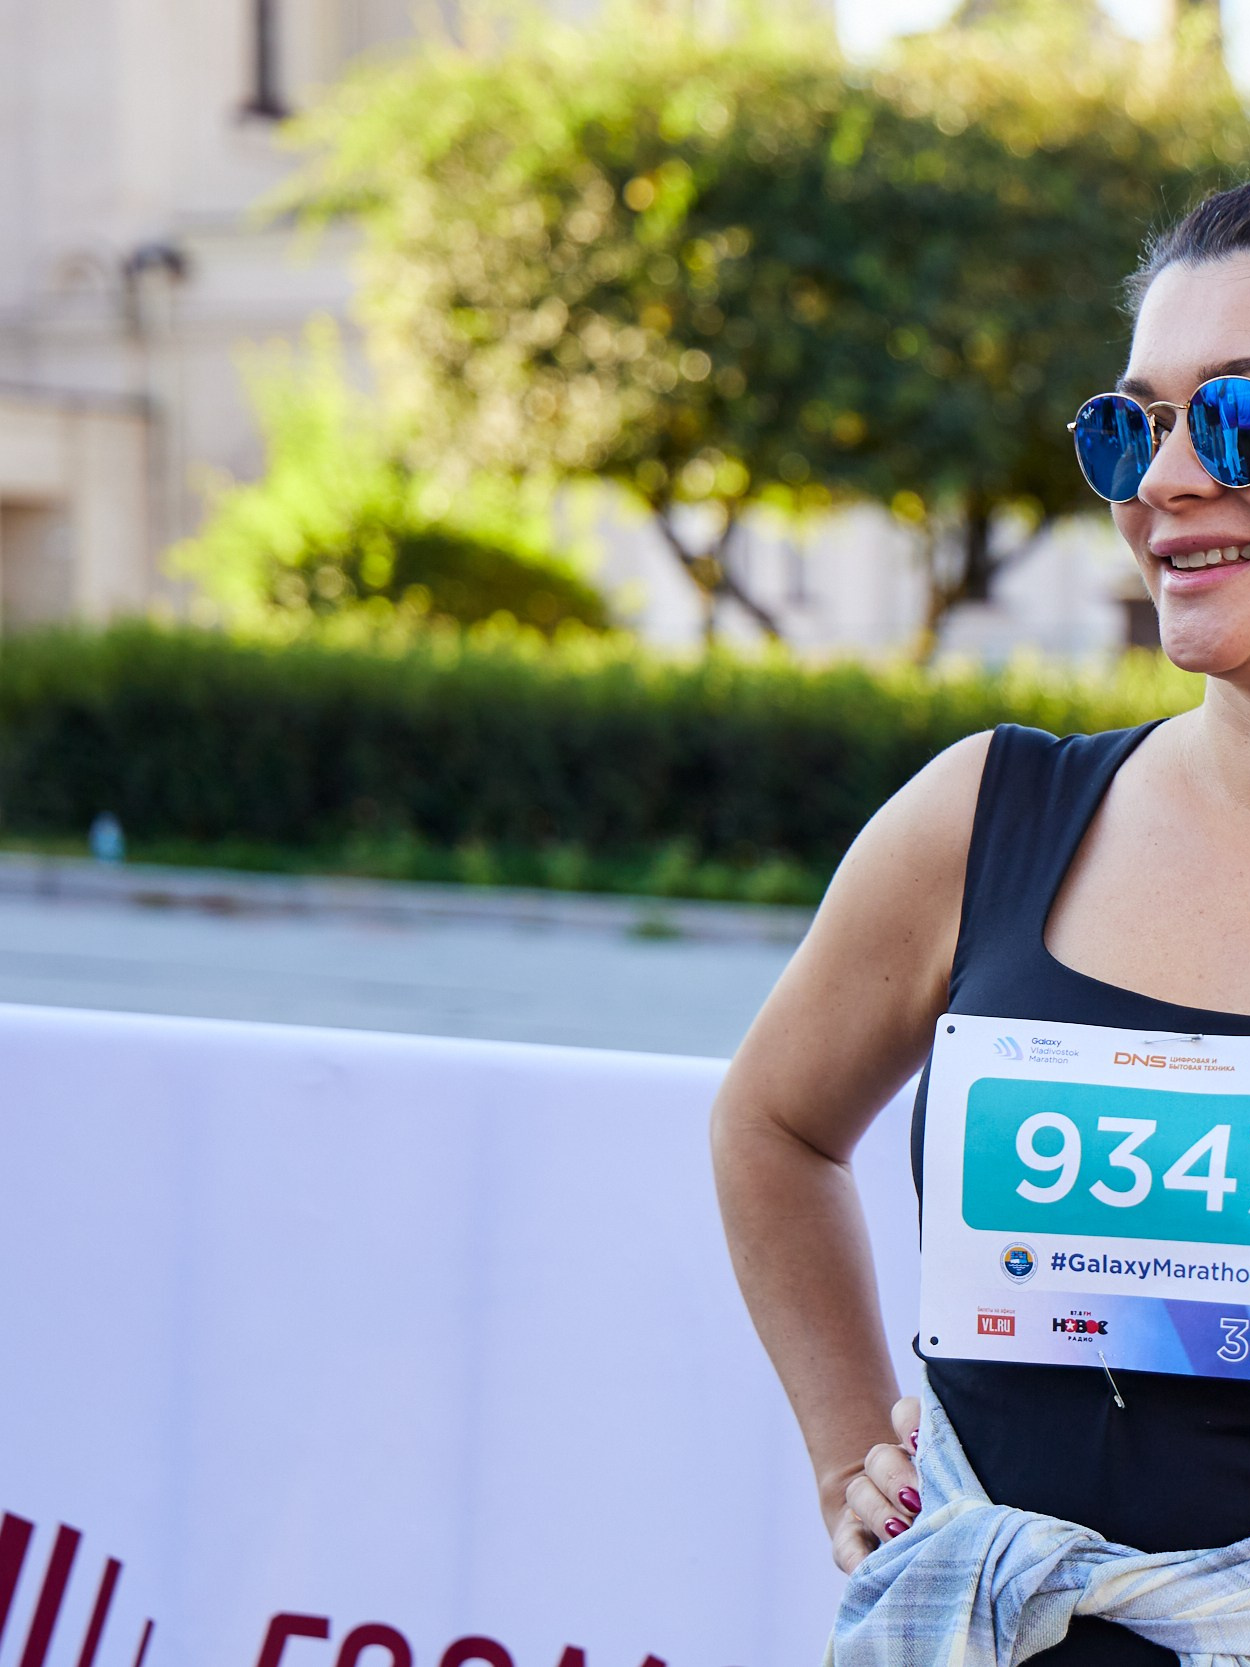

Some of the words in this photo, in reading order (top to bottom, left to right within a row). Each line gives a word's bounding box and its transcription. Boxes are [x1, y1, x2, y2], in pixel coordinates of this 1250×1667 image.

[1031, 1037, 1062, 1047] Galaxy
[1030, 1047, 1080, 1057] Vladivostok
[1028, 1056, 1069, 1064] Marathon
[1113, 1051, 1167, 1068] DNS
[1169, 1056, 1210, 1064] ЦИФРОВАЯ
[1168, 1063, 1202, 1071] БЫТОВАЯ
[981, 1317, 1011, 1333] VL.RU
[1067, 1335, 1094, 1343] РАДИО
